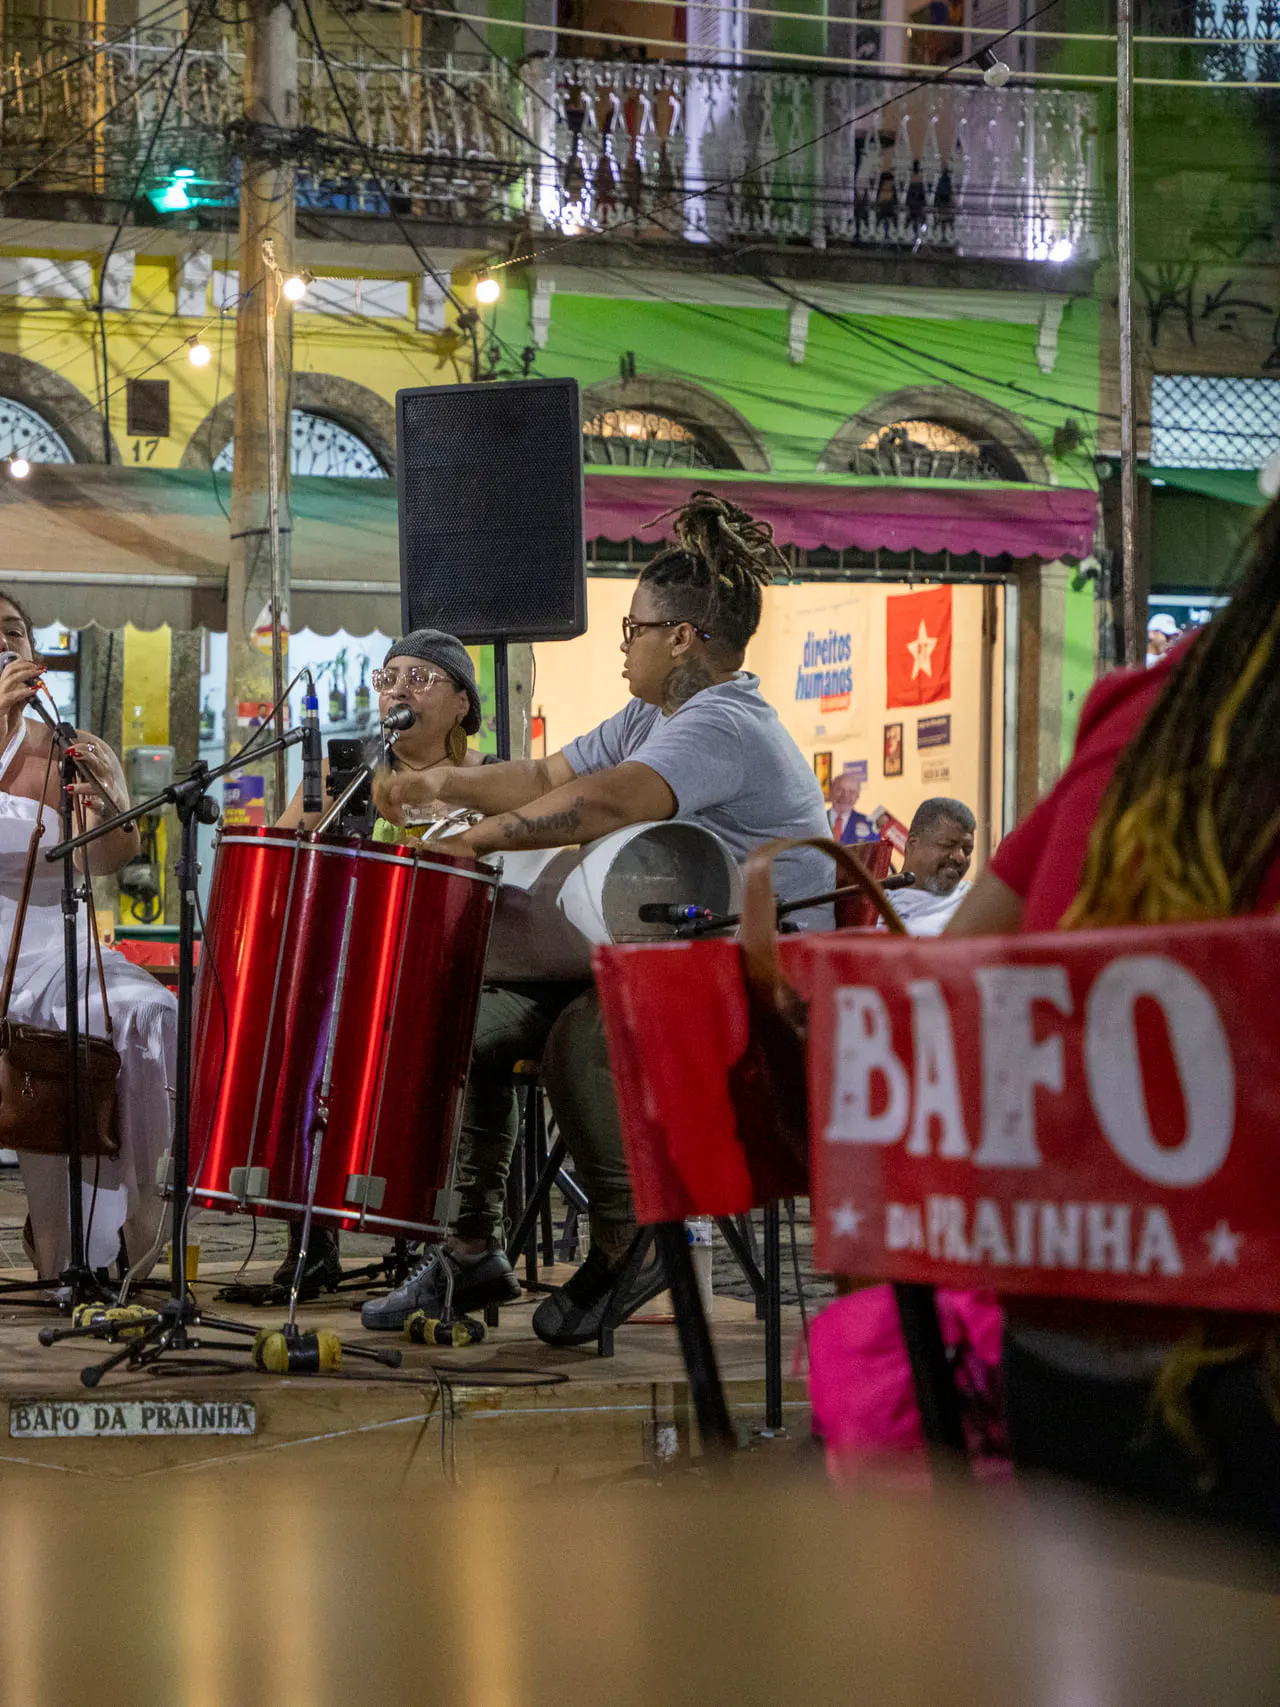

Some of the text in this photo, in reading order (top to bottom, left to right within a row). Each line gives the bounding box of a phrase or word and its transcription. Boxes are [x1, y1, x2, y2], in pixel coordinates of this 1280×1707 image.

[132, 438, 160, 463] 17
[803, 628, 852, 668] direitos
[795, 664, 853, 701] humanos
[823, 956, 1234, 1187] BAFO
[926, 1194, 1184, 1277] PRAINHA
[16, 1405, 250, 1430] BAFO DA PRAINHA
